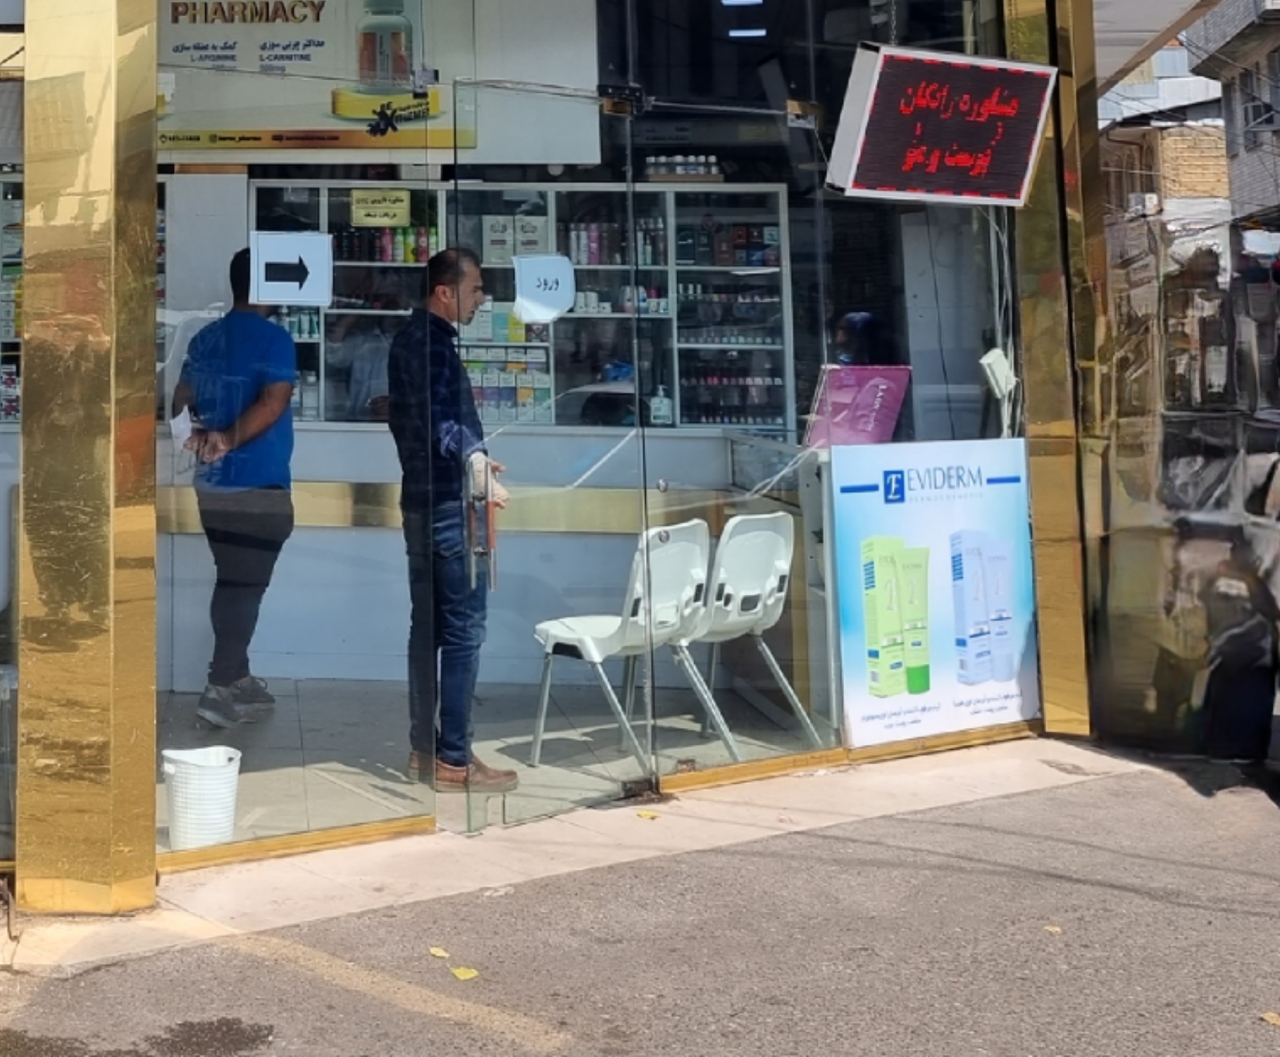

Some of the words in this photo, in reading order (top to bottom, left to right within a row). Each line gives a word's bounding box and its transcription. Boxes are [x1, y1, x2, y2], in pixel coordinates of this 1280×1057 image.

[171, 0, 326, 24] PHARMACY
[536, 277, 559, 291] ورود
[908, 466, 983, 491] EVIDERM
